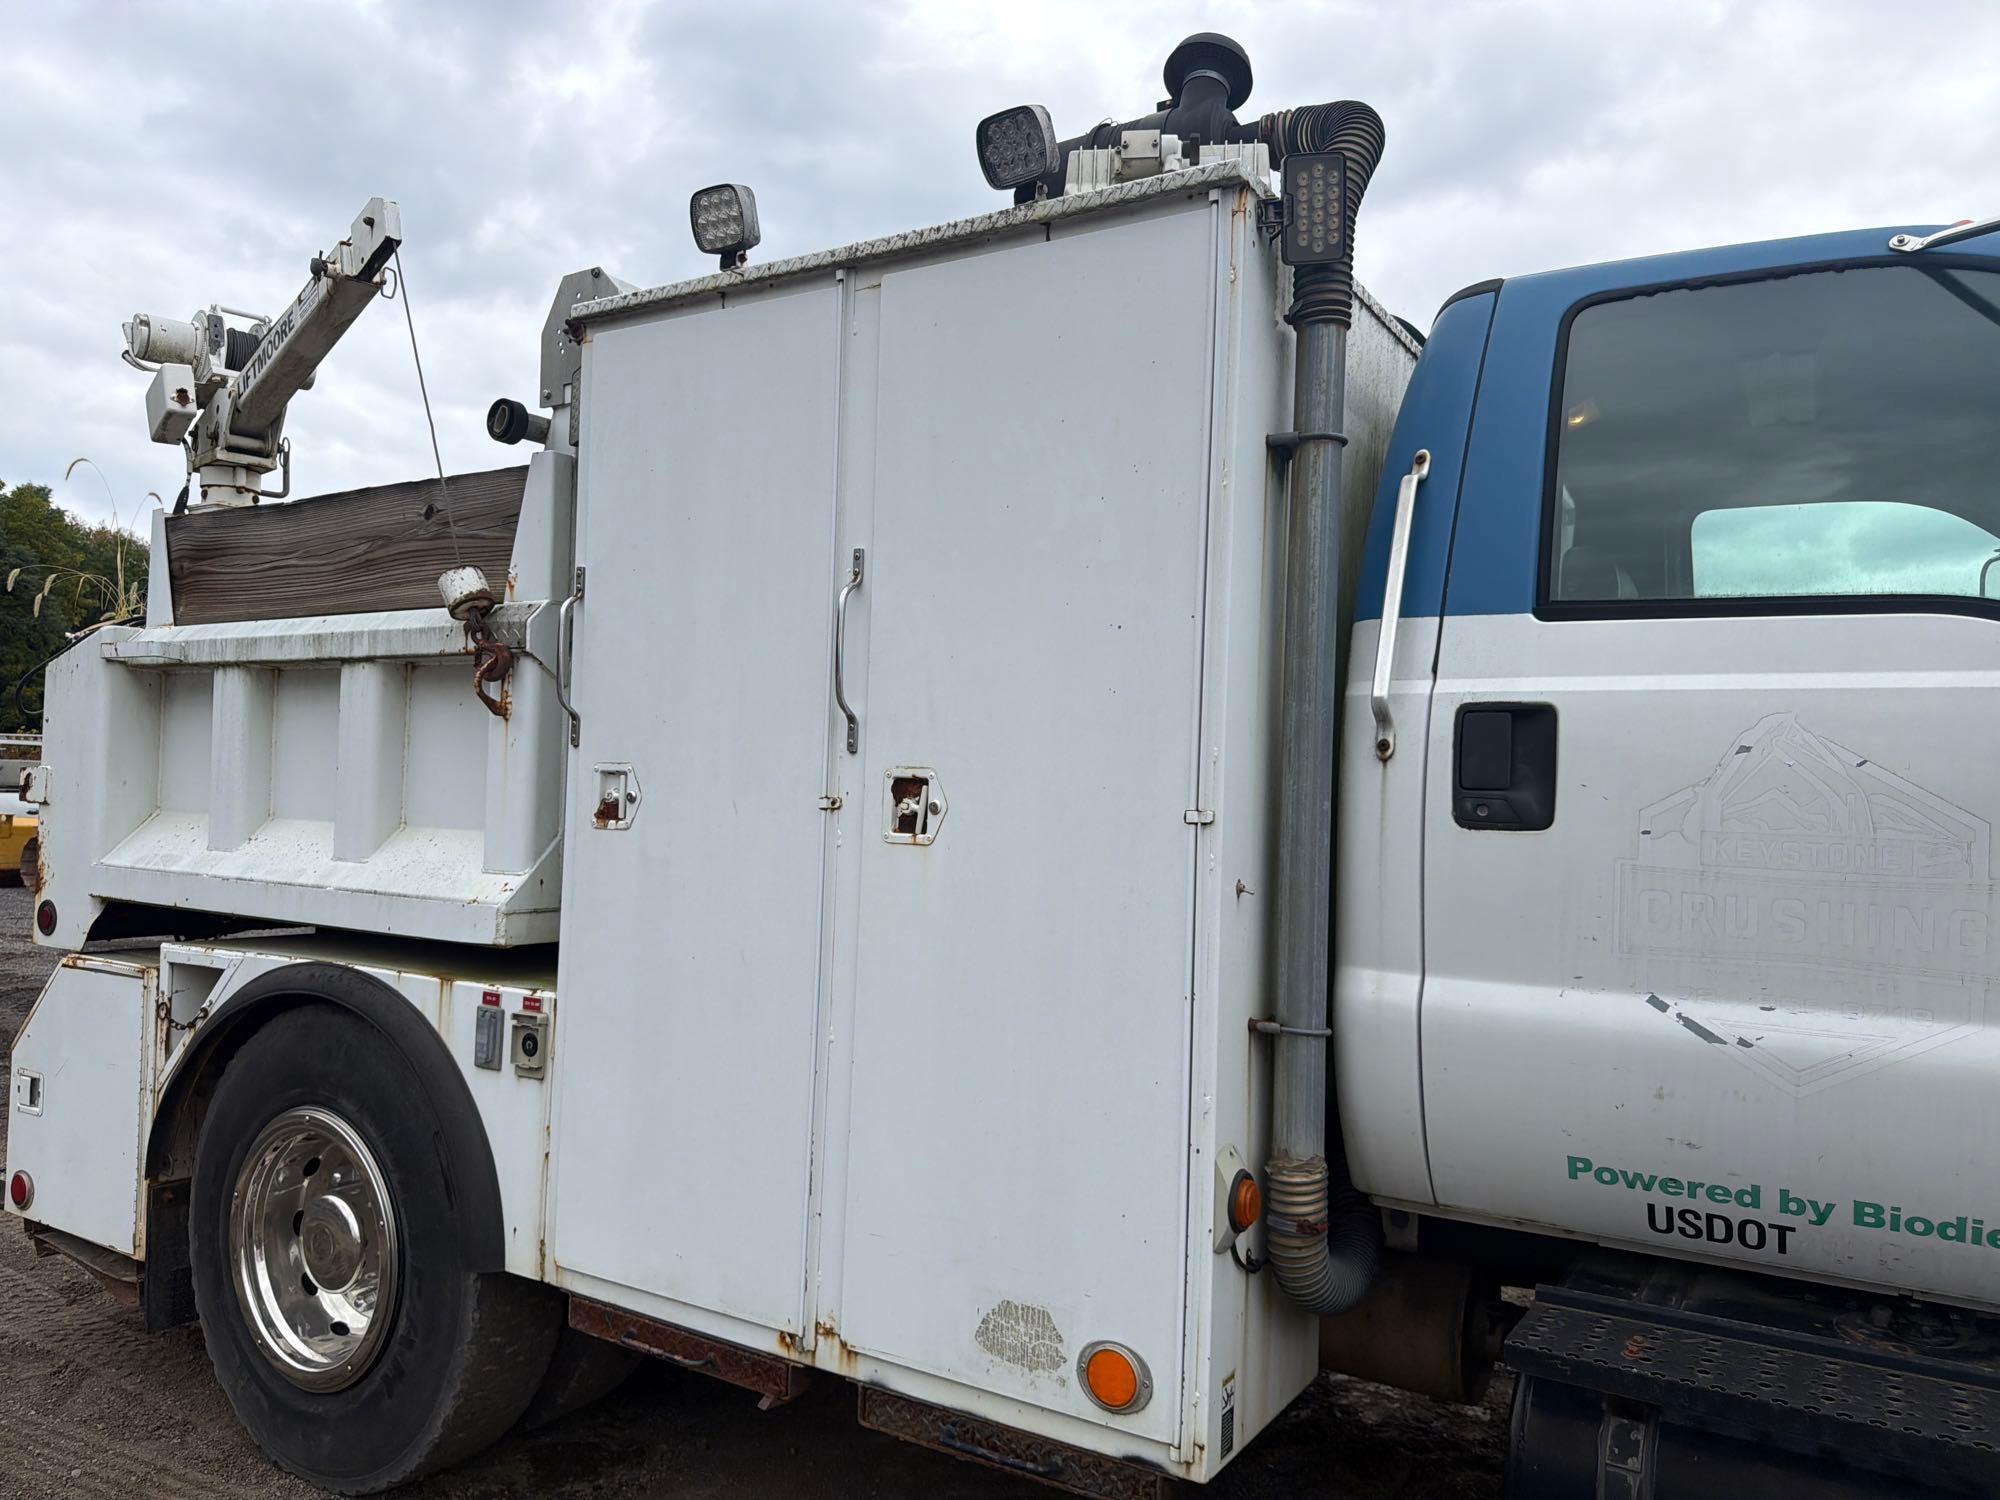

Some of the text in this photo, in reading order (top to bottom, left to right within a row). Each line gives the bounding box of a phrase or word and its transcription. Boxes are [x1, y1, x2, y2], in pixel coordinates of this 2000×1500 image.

[236, 310, 296, 400] LIFTMOORE
[1711, 838, 1898, 867] KEYSTONE
[1639, 888, 1990, 955] CRUSHING
[1566, 1154, 1762, 1211] Powered
[1778, 1188, 1837, 1227] by
[1646, 1202, 1797, 1256] USDOT
